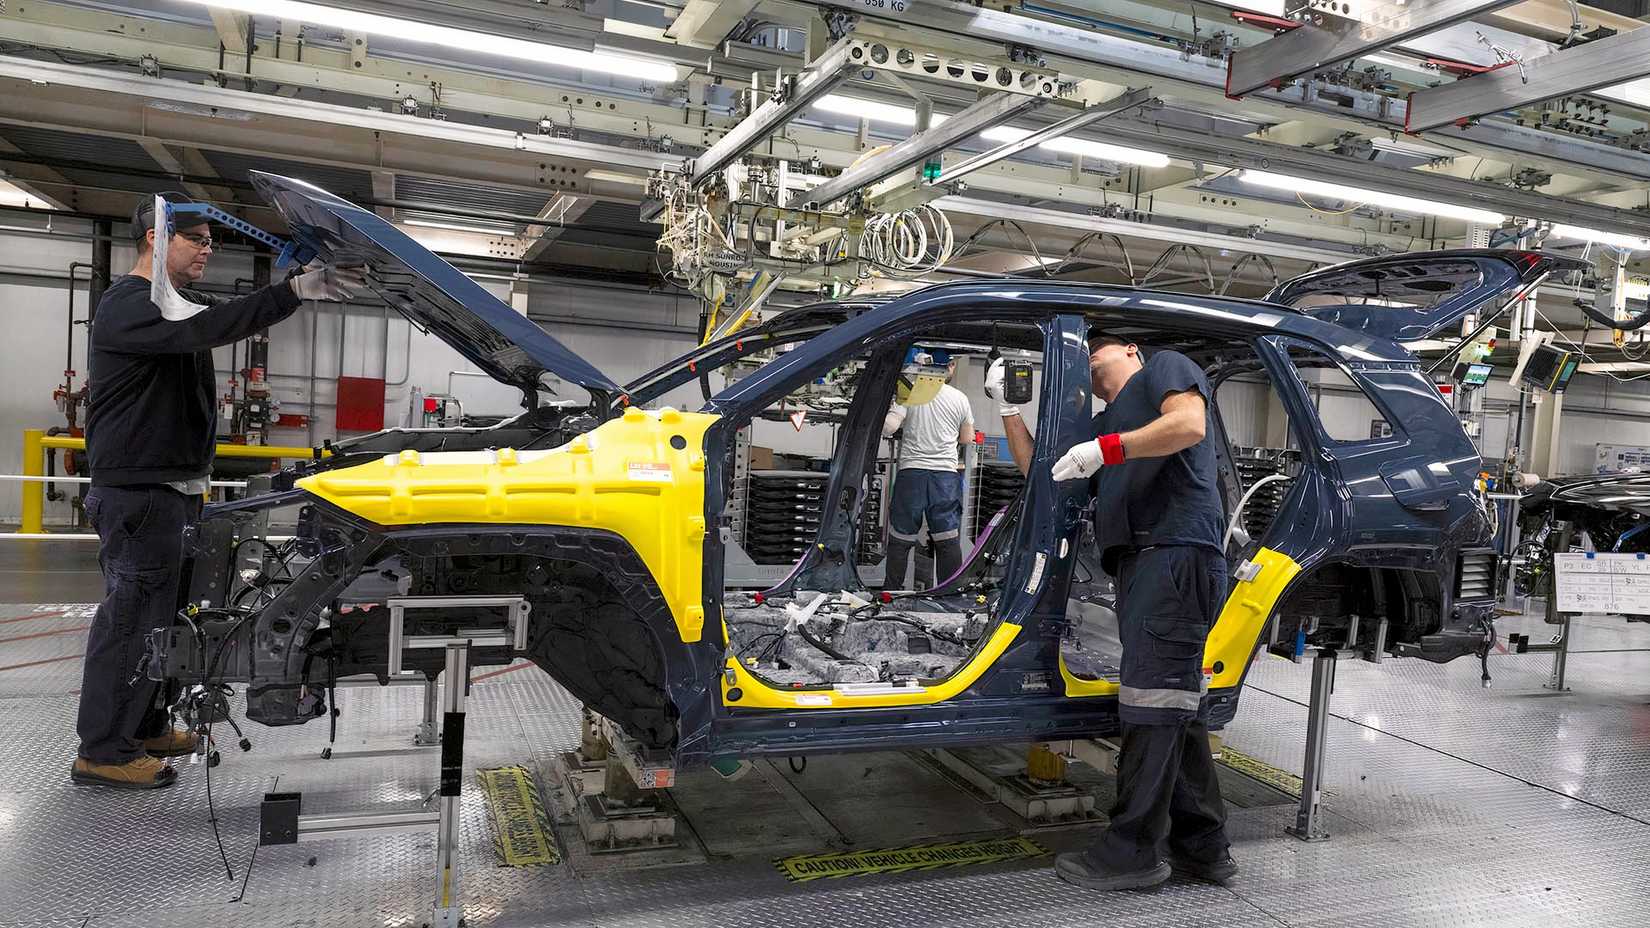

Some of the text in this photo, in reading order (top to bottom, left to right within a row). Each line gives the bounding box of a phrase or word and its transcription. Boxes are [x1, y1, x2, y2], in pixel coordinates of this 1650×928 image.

[891, 0, 904, 12] KG
[794, 840, 1030, 875] CAUTION! VEHICLE CHANGES HEIGHT
